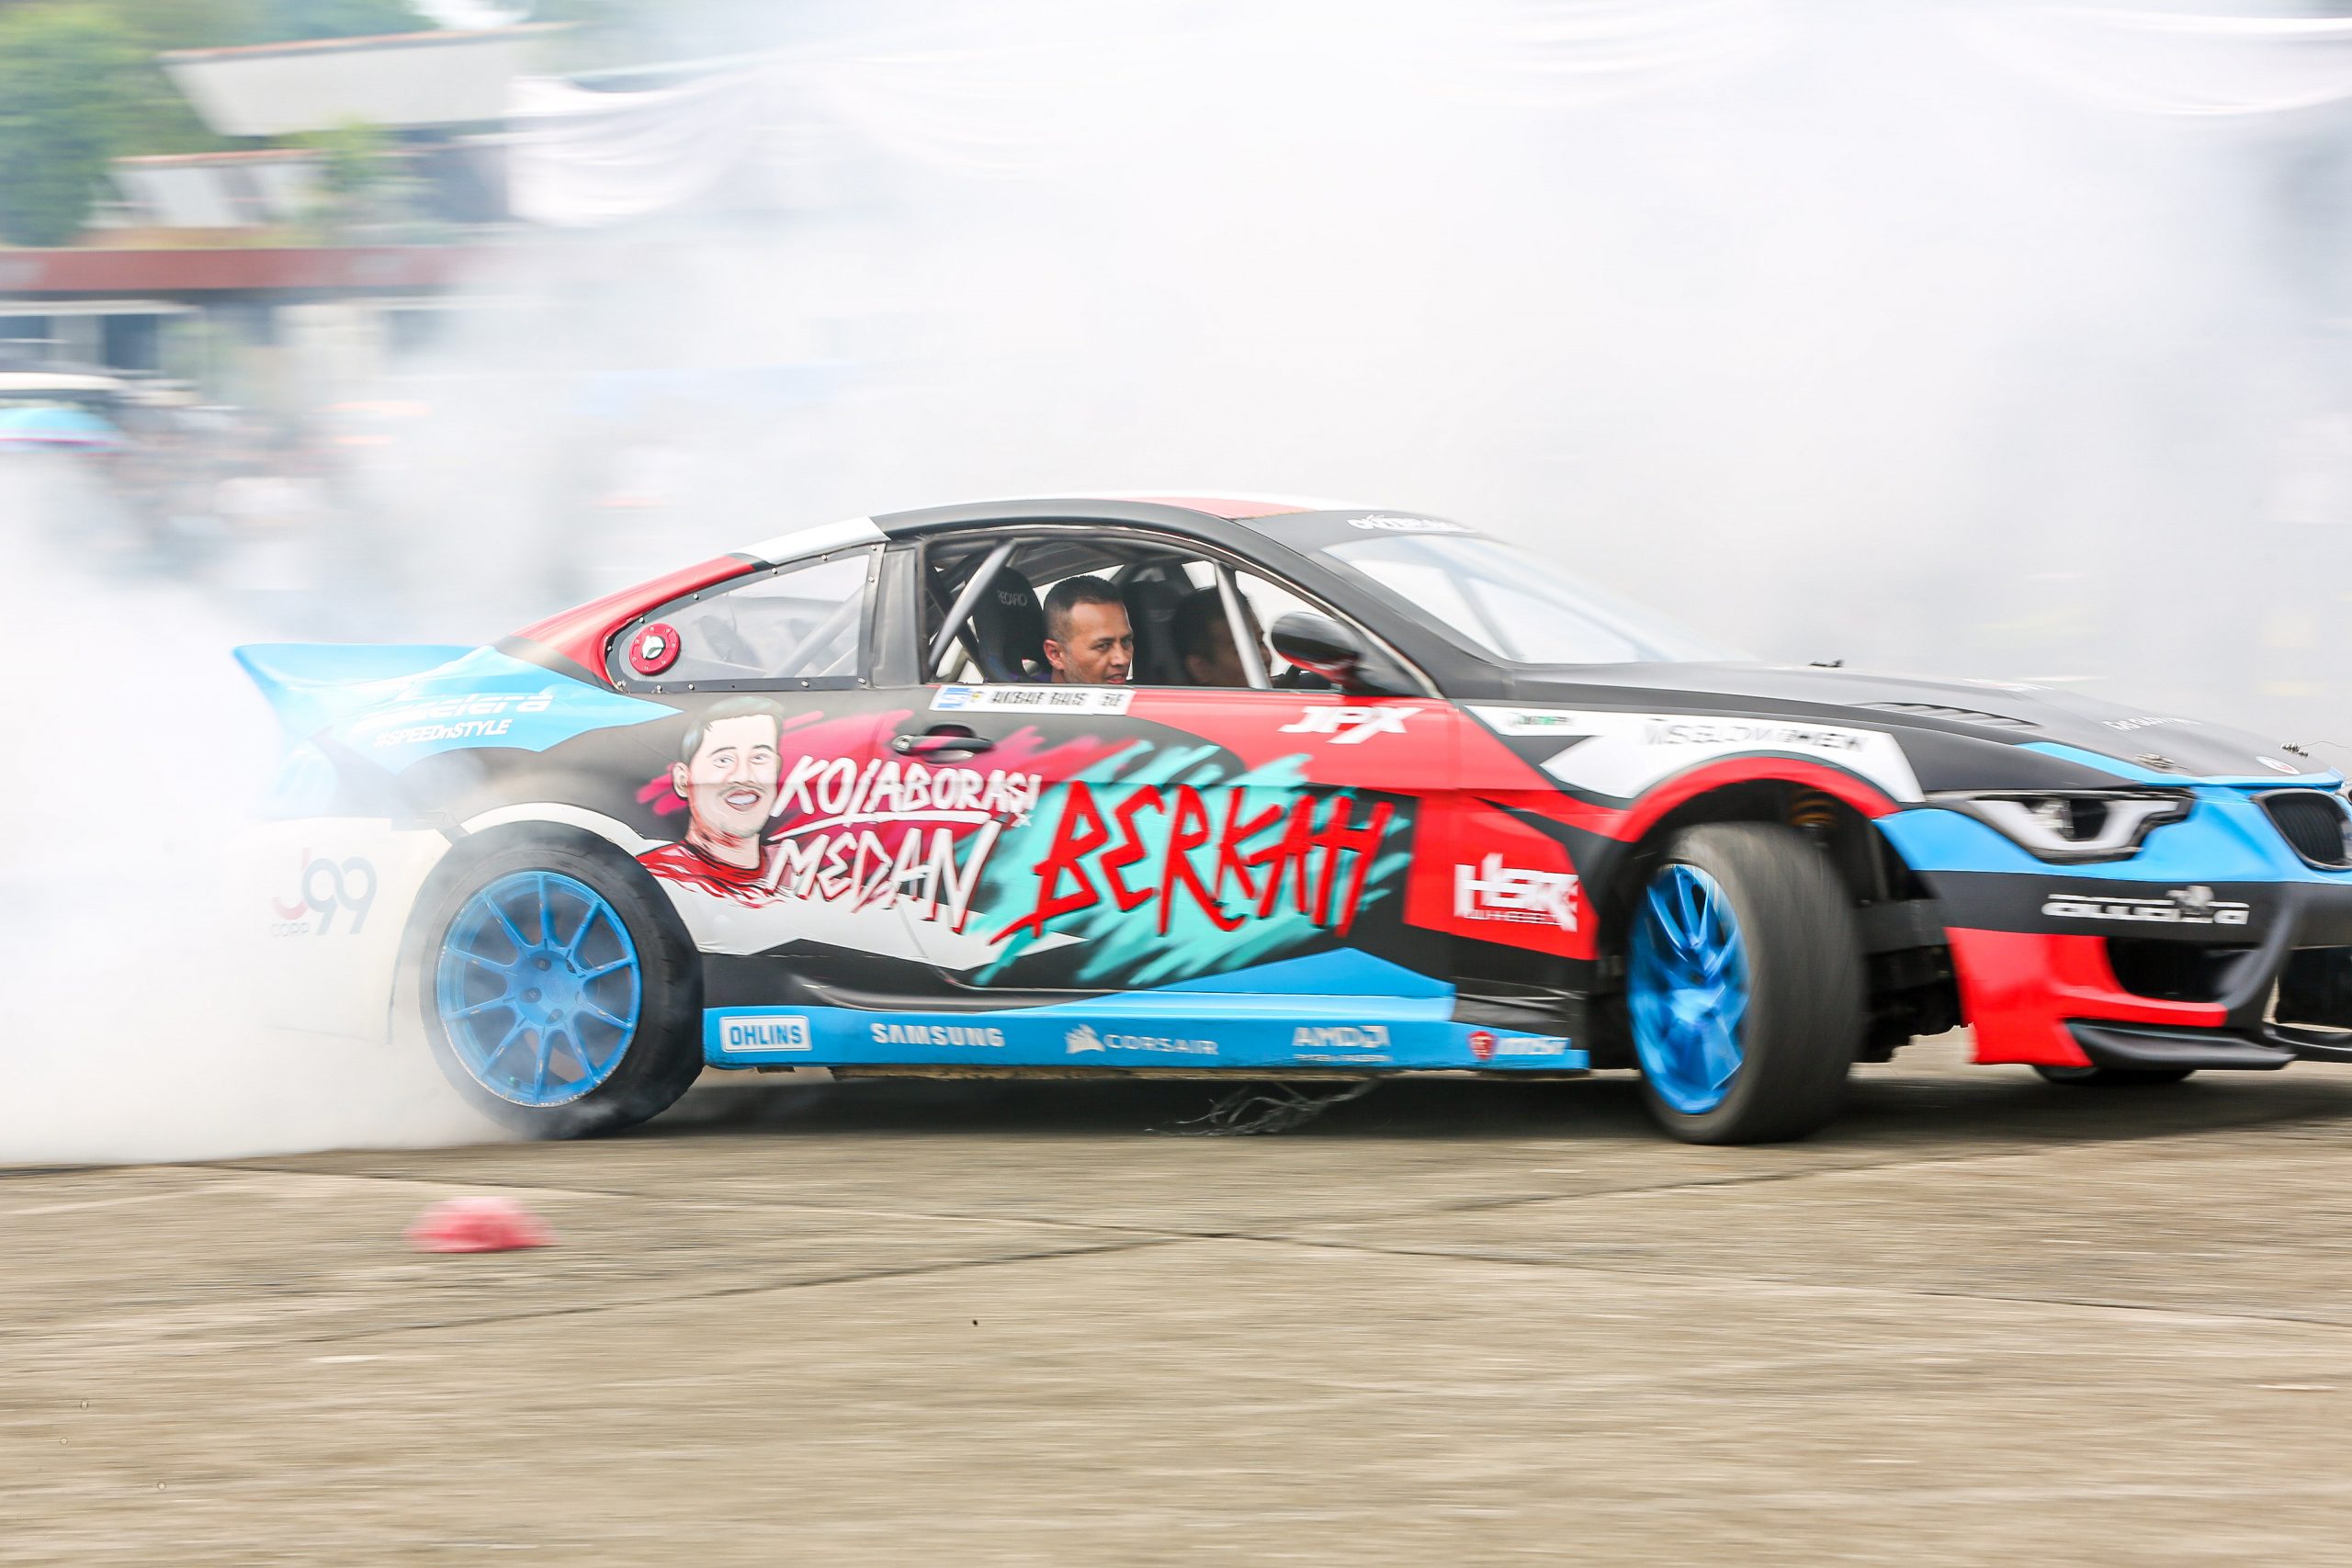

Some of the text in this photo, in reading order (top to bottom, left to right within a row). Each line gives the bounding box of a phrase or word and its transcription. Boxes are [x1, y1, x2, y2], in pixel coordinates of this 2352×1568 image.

[1278, 705, 1425, 744] JPX
[764, 819, 1004, 935] MEDAN
[988, 780, 1394, 944] BERKAH
[869, 1022, 1006, 1047] SAMSUNG
[1102, 1033, 1220, 1055] CORSAIR
[1291, 1026, 1363, 1047] AMD
